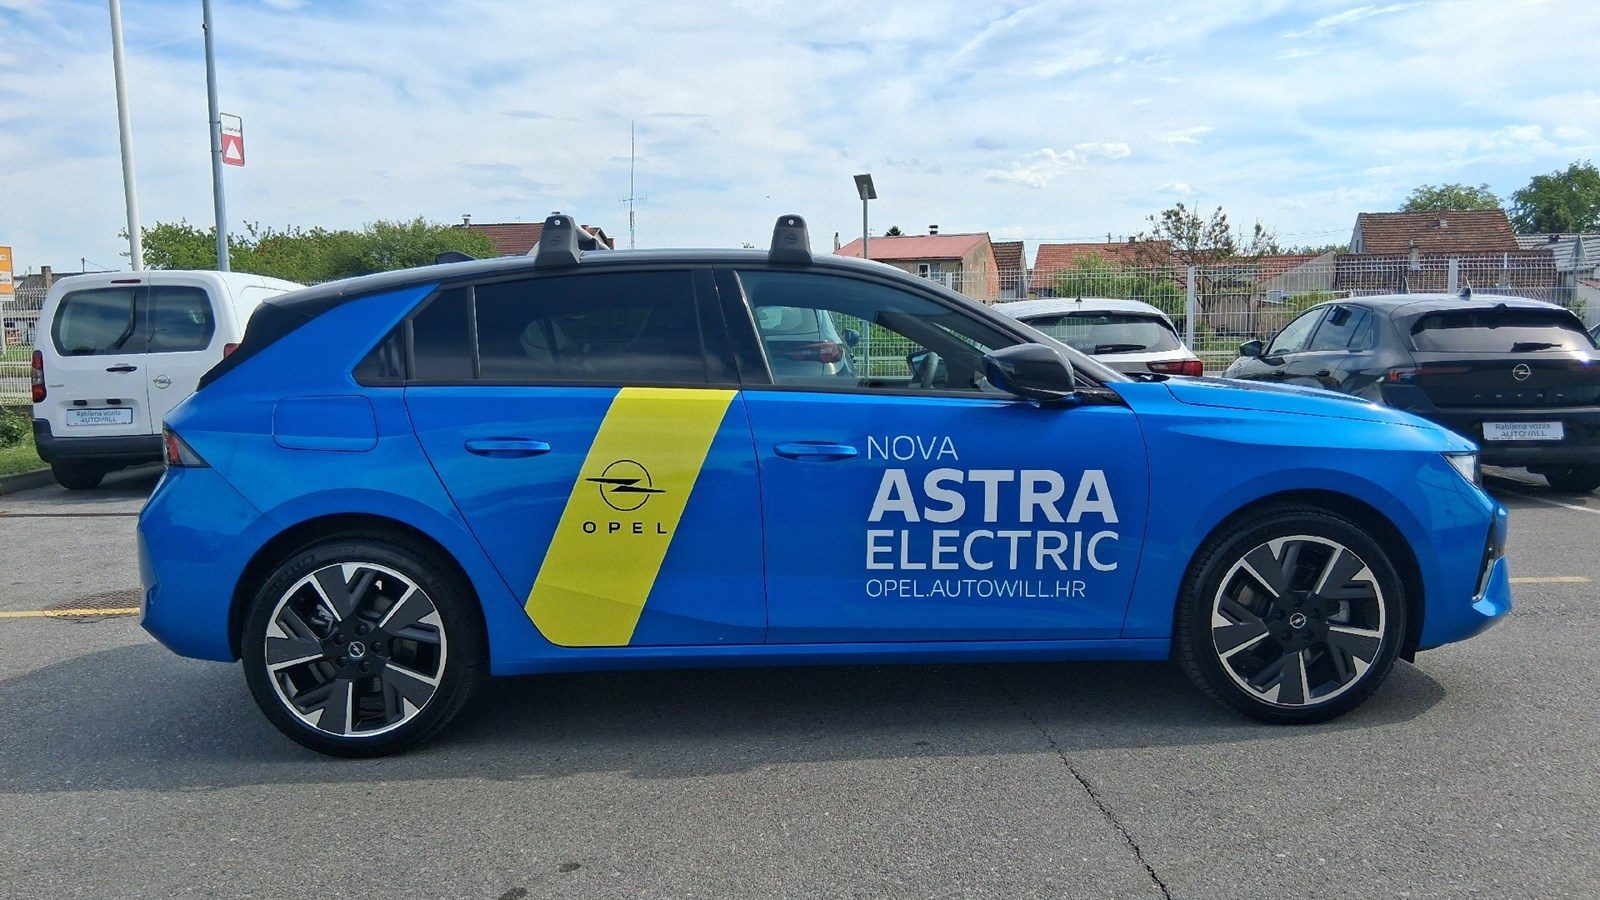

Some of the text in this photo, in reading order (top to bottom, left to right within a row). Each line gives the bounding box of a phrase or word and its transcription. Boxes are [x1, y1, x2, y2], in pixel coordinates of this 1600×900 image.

[1495, 423, 1528, 431] Rabljena
[867, 436, 959, 461] NOVA
[867, 468, 1119, 523] ASTRA
[582, 521, 667, 534] OPEL
[866, 529, 1119, 571] ELECTRIC
[866, 578, 1086, 598] OPEL.AUTOWILL.HR
